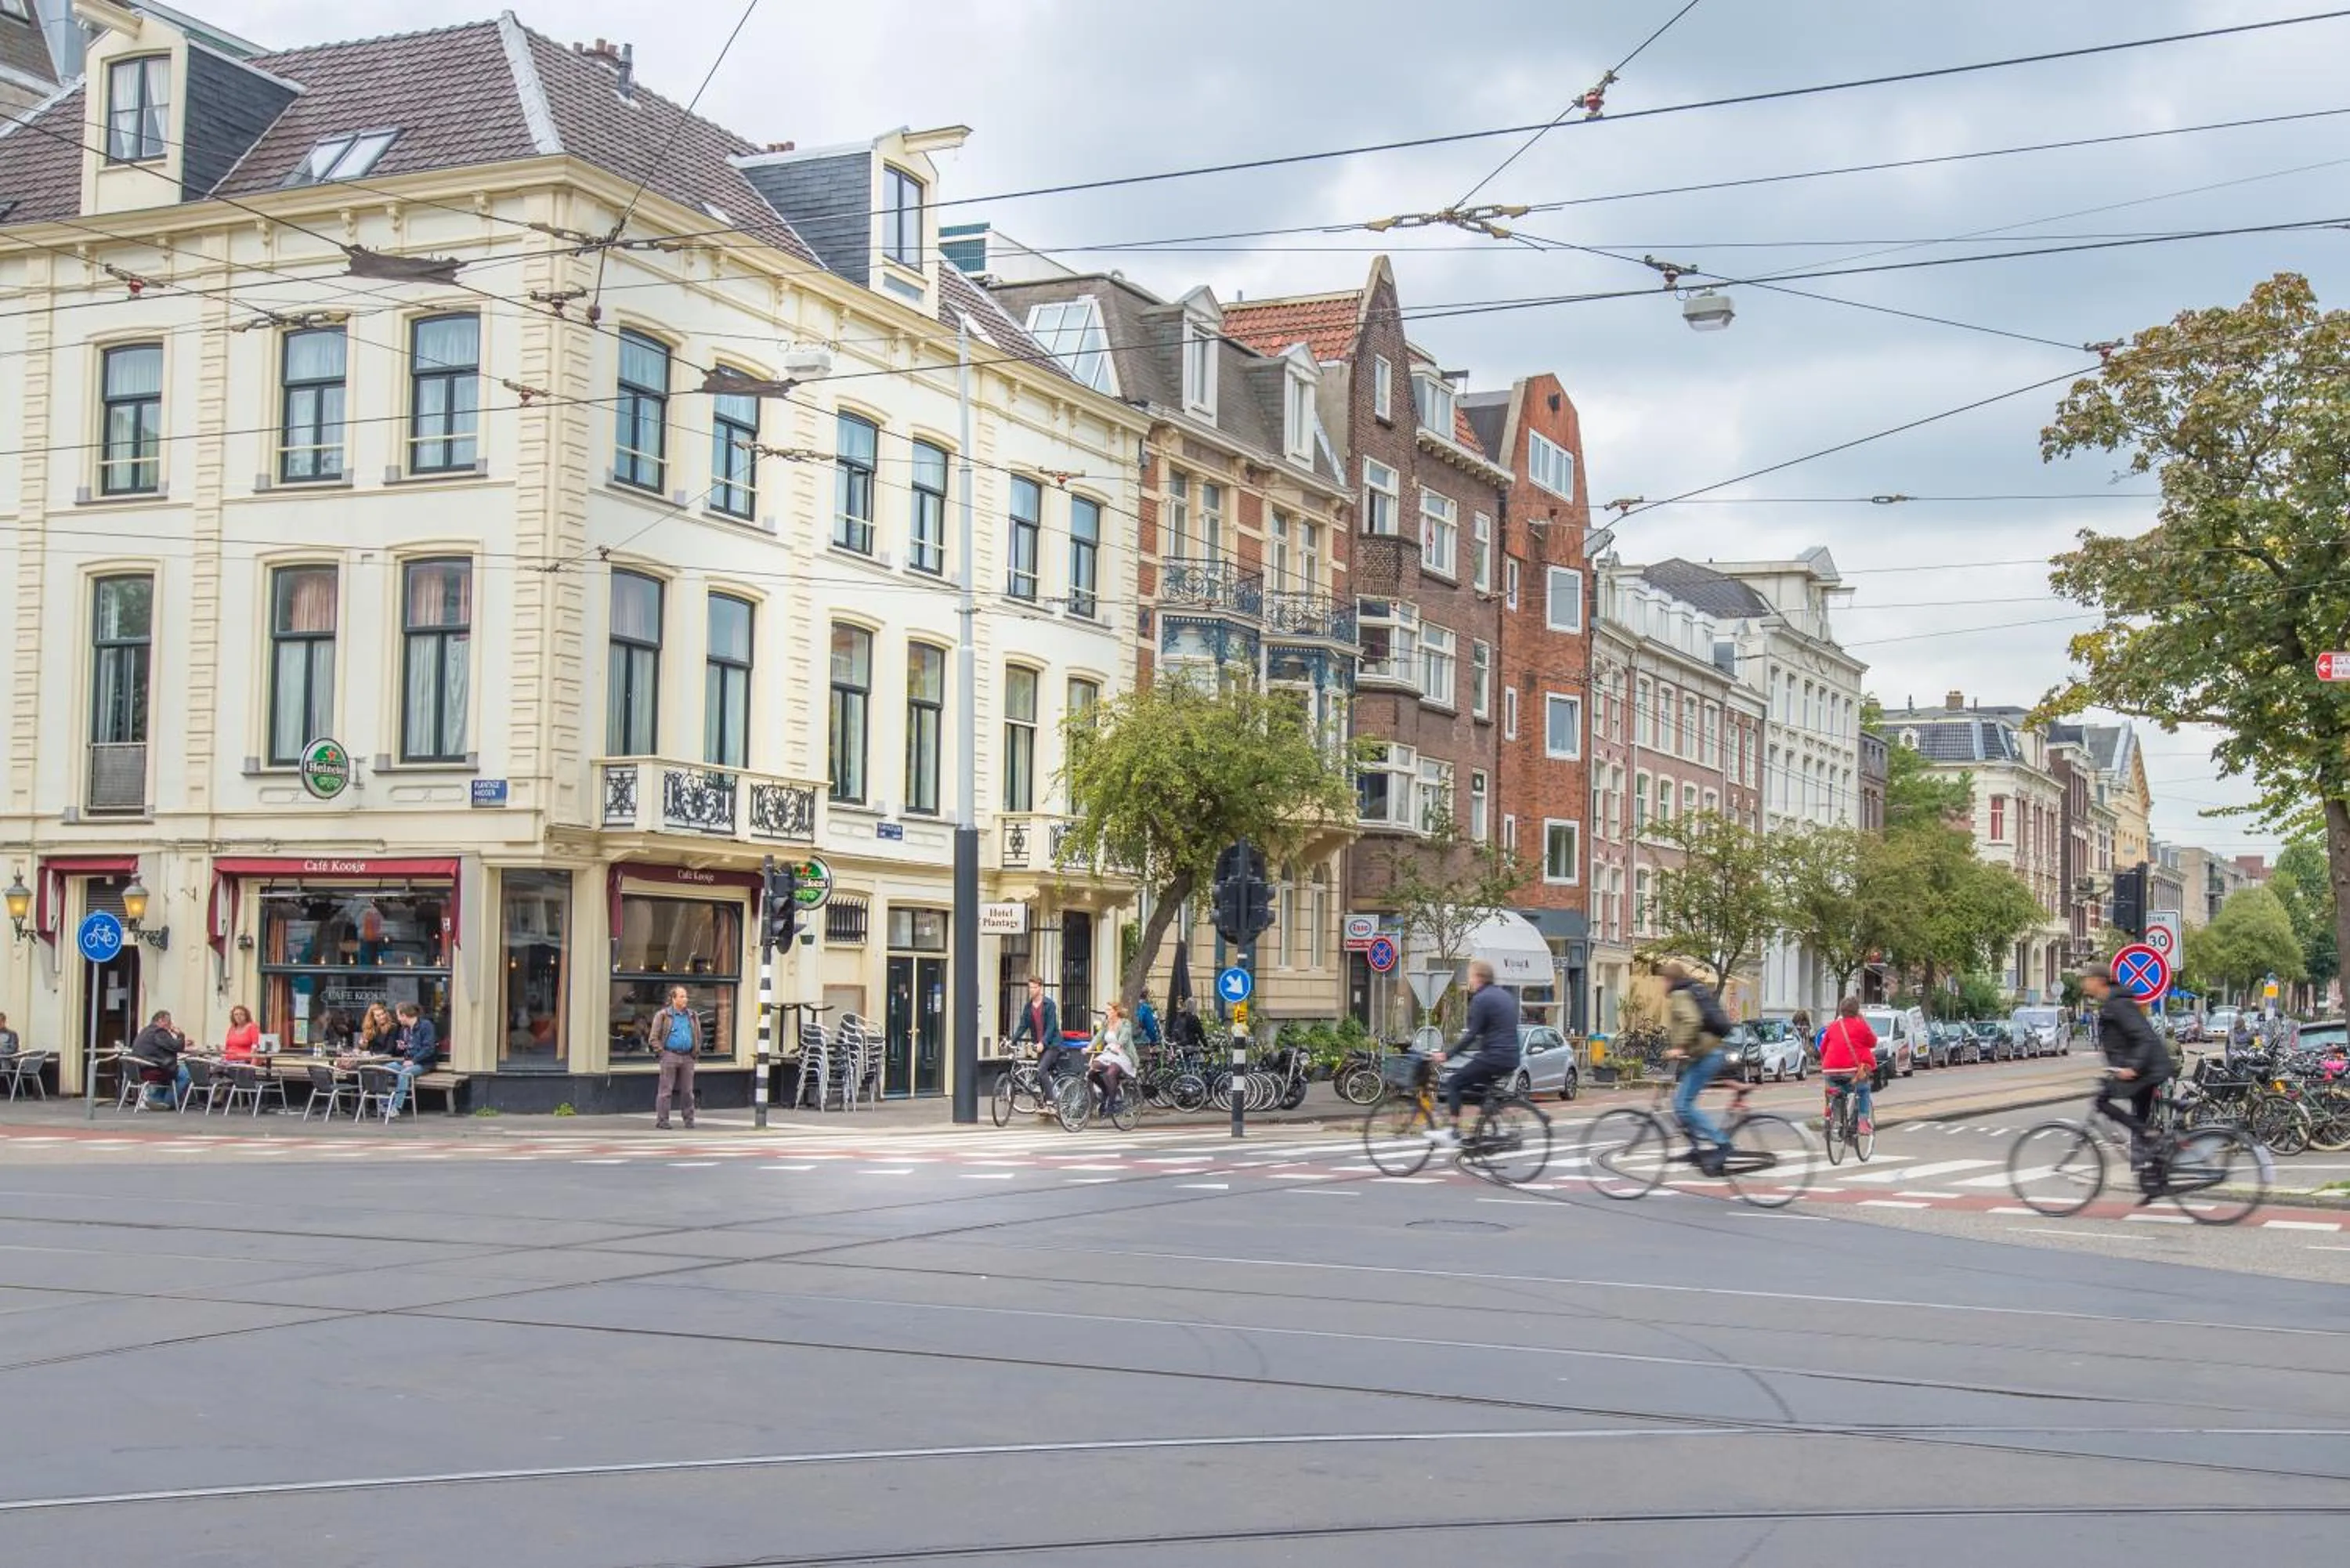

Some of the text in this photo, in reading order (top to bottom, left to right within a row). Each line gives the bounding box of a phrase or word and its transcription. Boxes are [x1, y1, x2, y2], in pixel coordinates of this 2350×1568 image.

[304, 860, 366, 875] Café Koosje
[989, 908, 1013, 917] Hotel
[2149, 934, 2167, 947] 30
